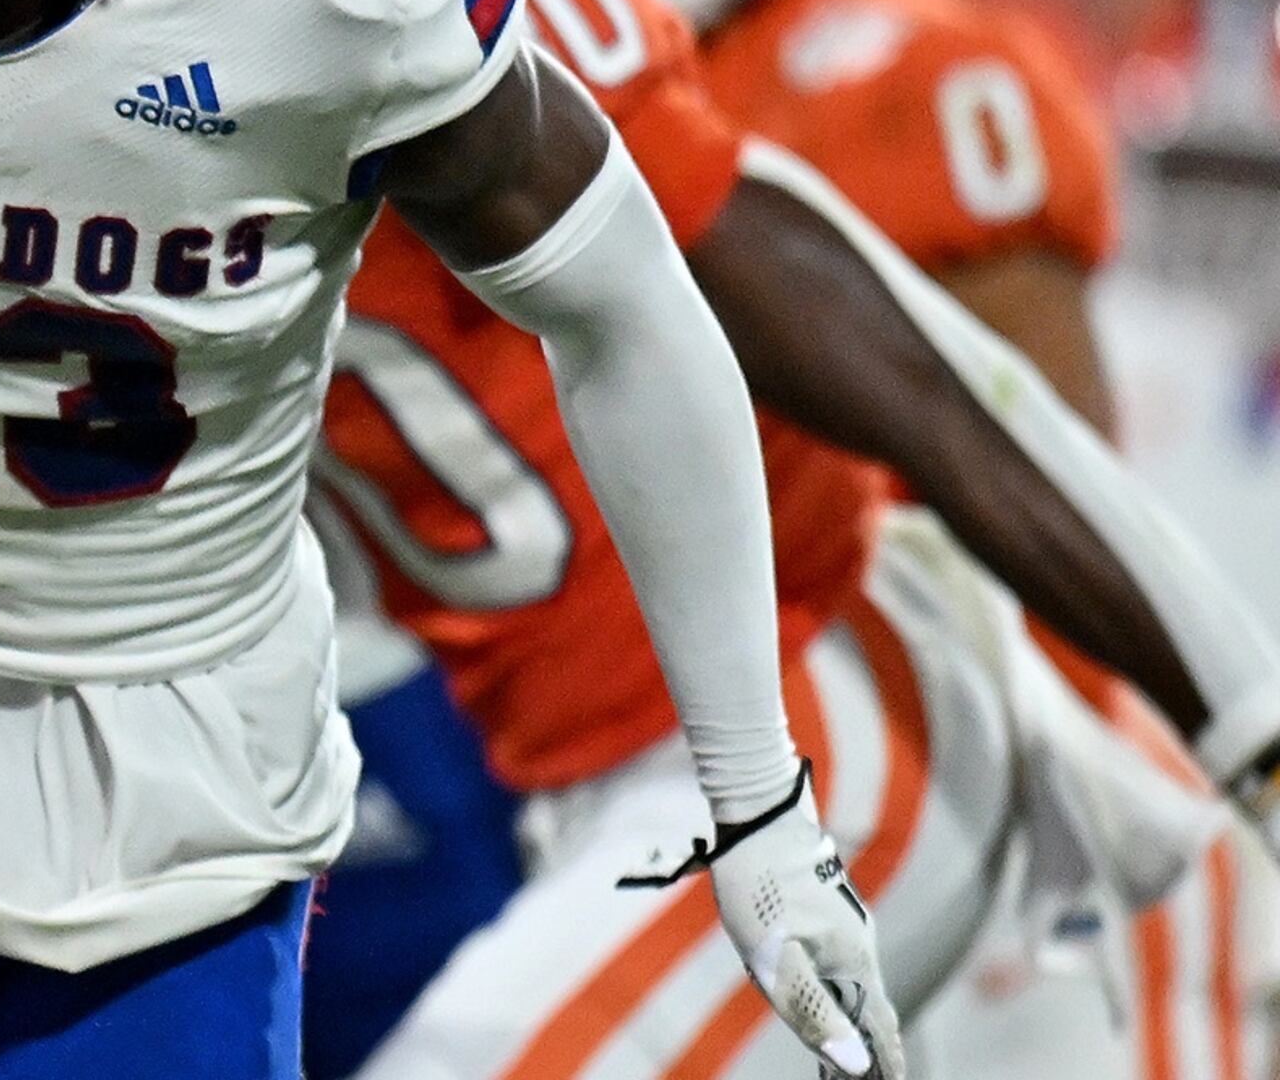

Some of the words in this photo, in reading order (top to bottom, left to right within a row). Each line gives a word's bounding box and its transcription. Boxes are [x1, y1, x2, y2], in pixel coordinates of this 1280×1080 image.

[115, 98, 237, 137] adidas
[936, 58, 1050, 225] 0
[307, 314, 573, 611] 0
